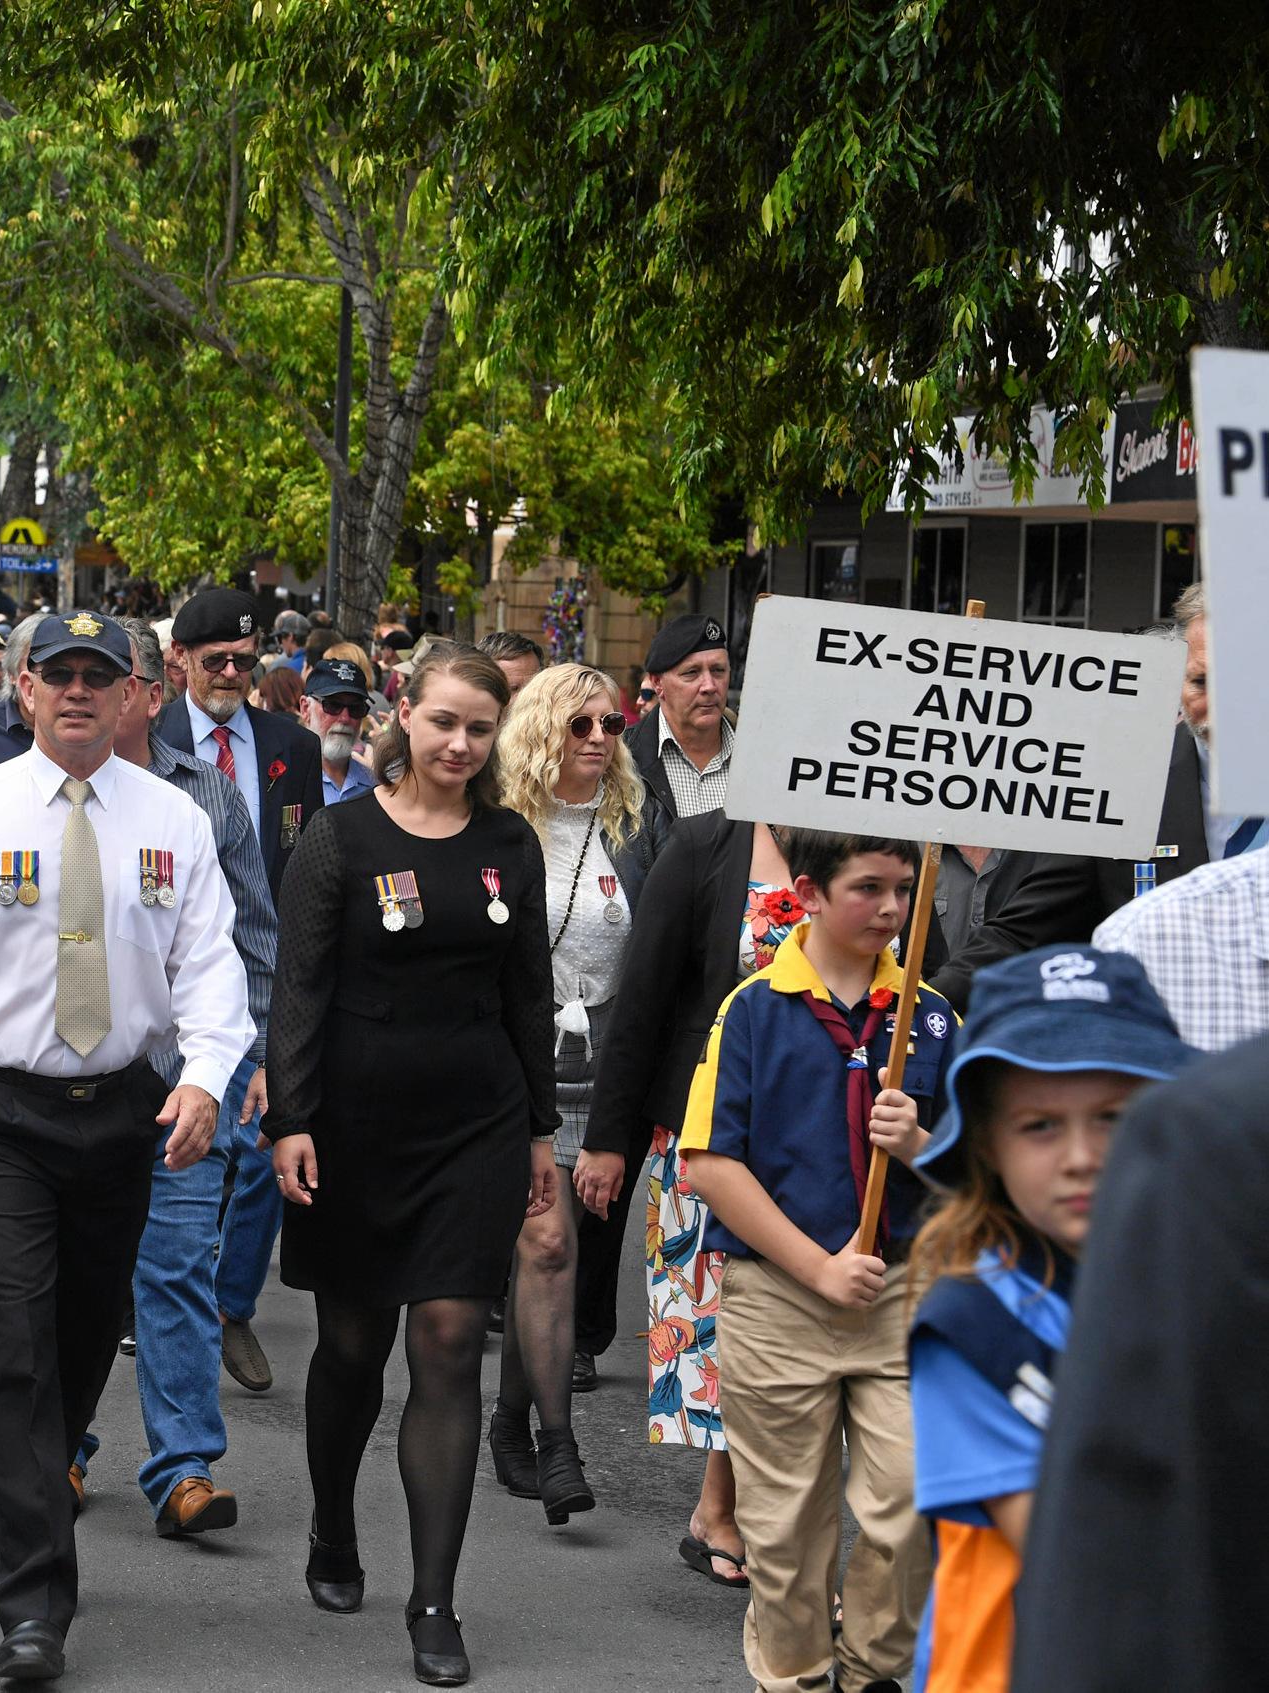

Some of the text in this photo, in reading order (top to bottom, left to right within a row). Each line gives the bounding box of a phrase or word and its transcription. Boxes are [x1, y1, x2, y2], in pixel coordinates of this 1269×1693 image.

[944, 491, 972, 507] STYLES
[815, 627, 1141, 697] EX-SERVICE
[913, 684, 1032, 727] AND
[847, 720, 1085, 778] SERVICE
[787, 757, 1124, 826] PERSONNEL
